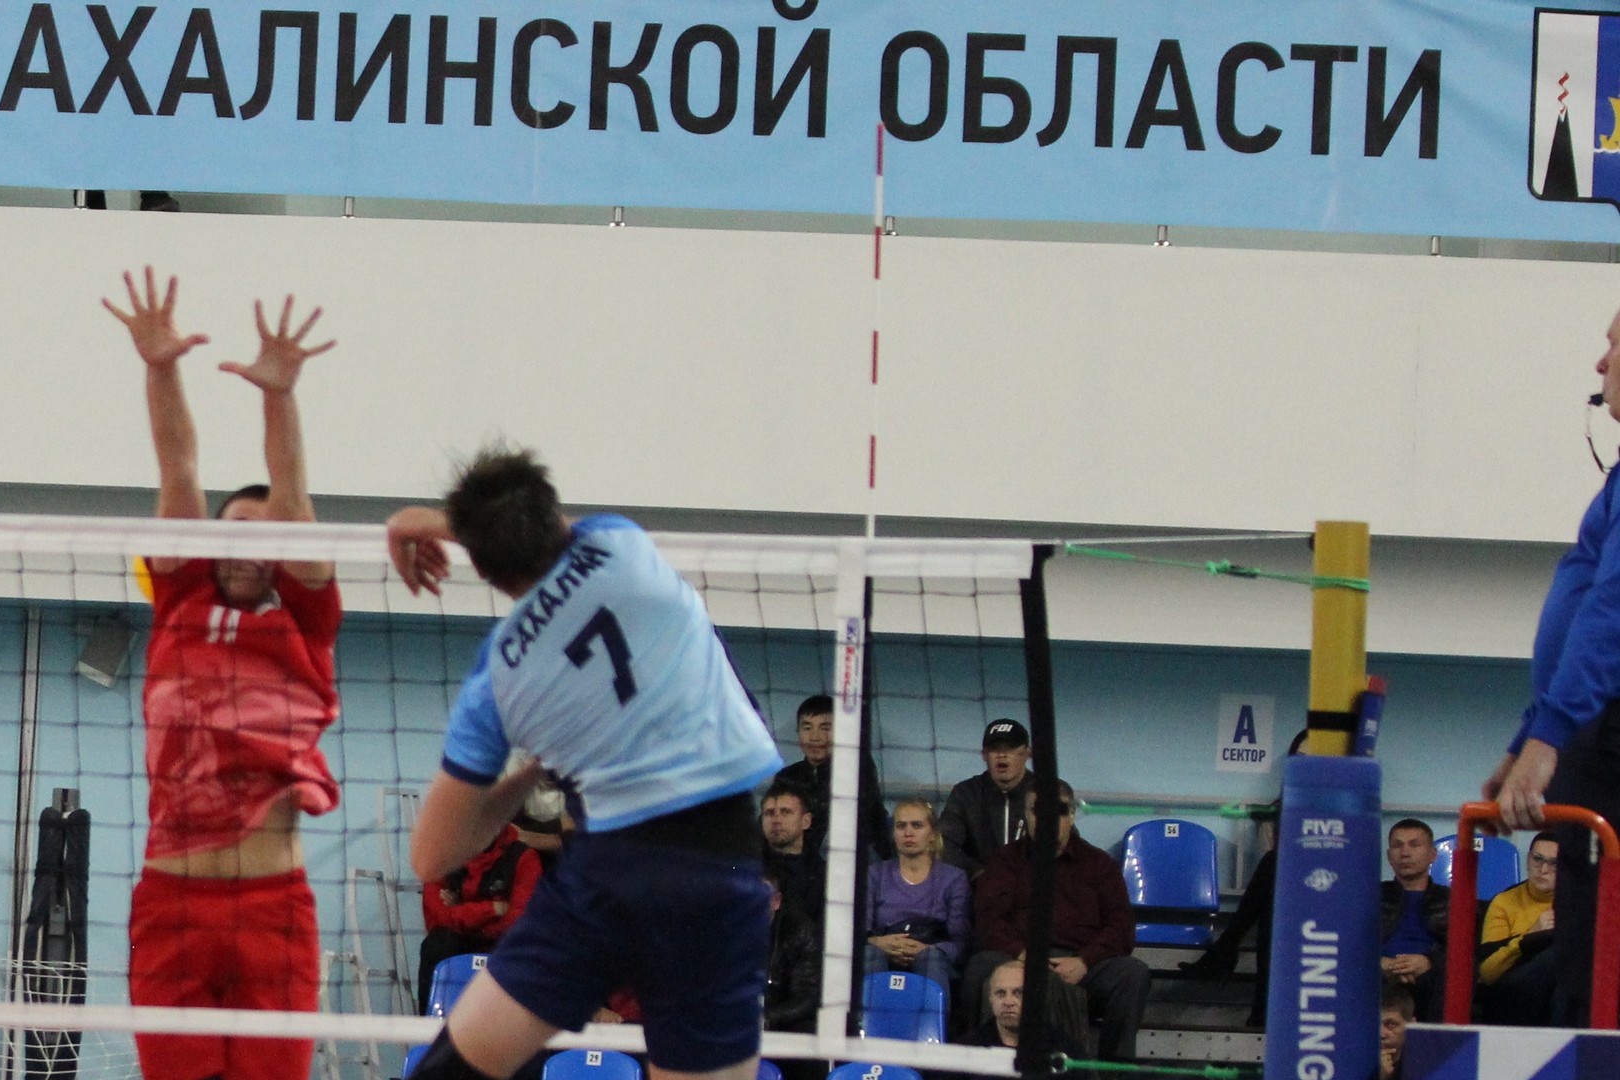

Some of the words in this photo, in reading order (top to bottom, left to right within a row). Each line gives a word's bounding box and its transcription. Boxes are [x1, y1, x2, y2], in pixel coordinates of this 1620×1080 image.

[879, 29, 1442, 160] ОБЛАСТИ
[564, 604, 638, 708] 7
[989, 723, 1013, 735] FBI
[1232, 704, 1257, 745] А
[1222, 747, 1266, 763] СЕКТОР
[1302, 818, 1346, 836] FIVB
